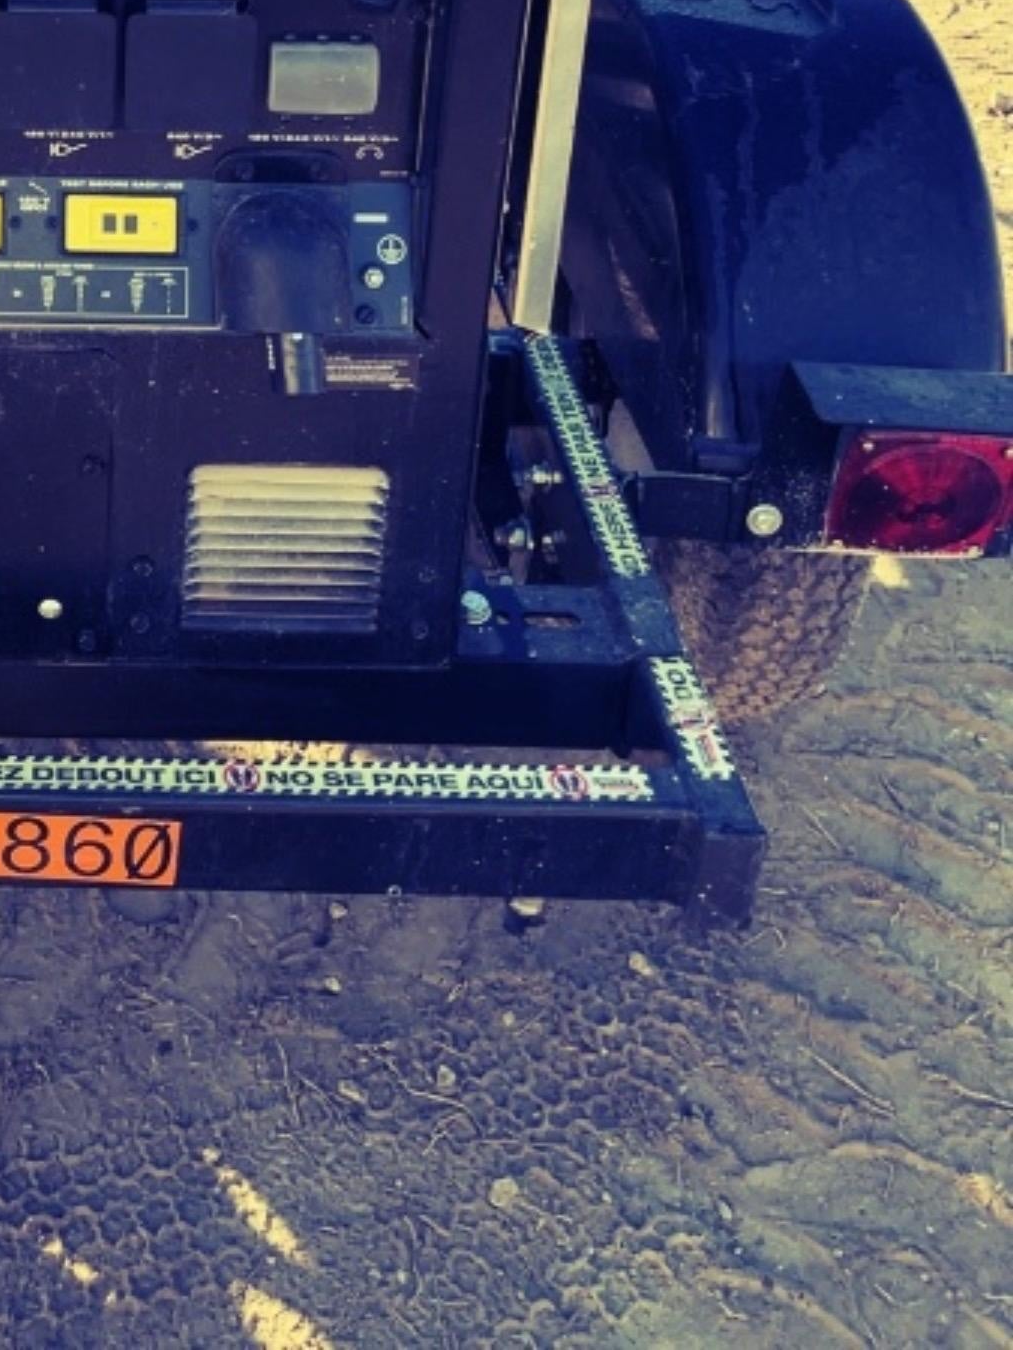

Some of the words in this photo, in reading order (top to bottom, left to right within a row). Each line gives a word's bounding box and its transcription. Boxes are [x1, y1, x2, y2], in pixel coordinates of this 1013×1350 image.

[31, 767, 169, 784] DEBOUT
[175, 769, 216, 785] ICI
[265, 771, 316, 788] NO
[322, 771, 365, 788] SE
[373, 773, 456, 789] PARE
